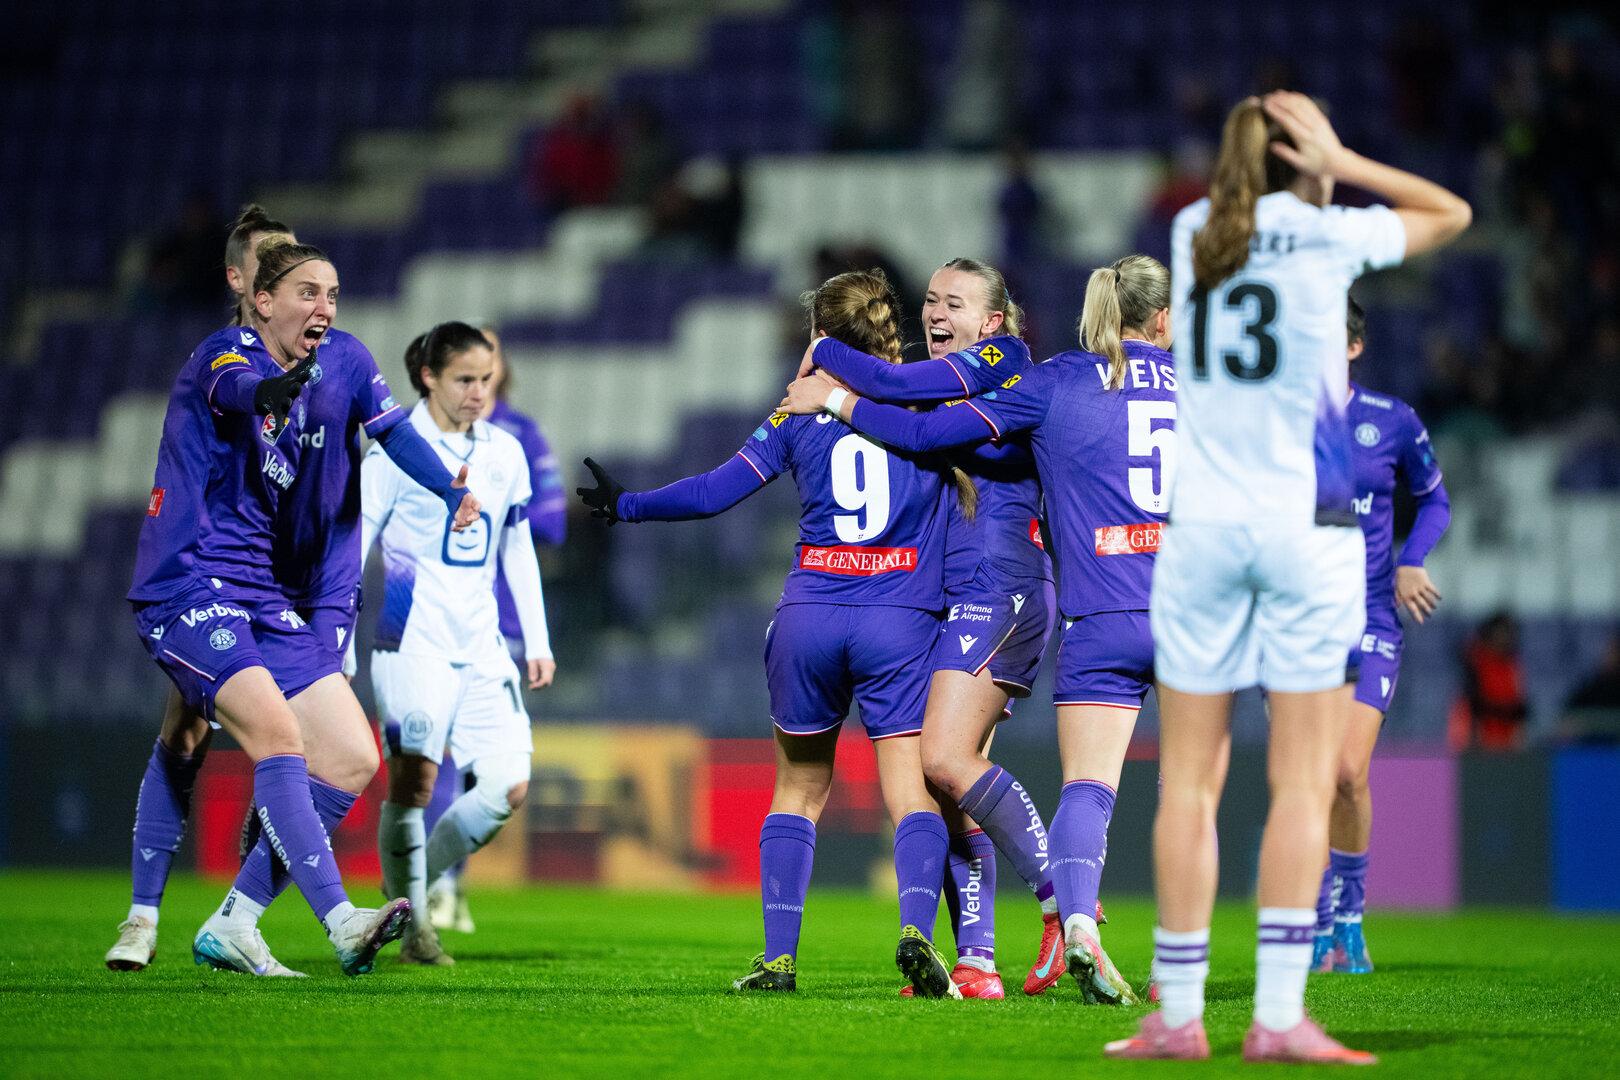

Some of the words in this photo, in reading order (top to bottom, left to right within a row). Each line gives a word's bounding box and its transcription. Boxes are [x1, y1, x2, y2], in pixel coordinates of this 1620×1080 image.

[1189, 282, 1281, 383] 13
[1127, 400, 1179, 514] 5
[831, 433, 890, 543] 9
[826, 551, 912, 571] GENERALI
[960, 612, 992, 622] Airport
[963, 604, 993, 613] Vienna
